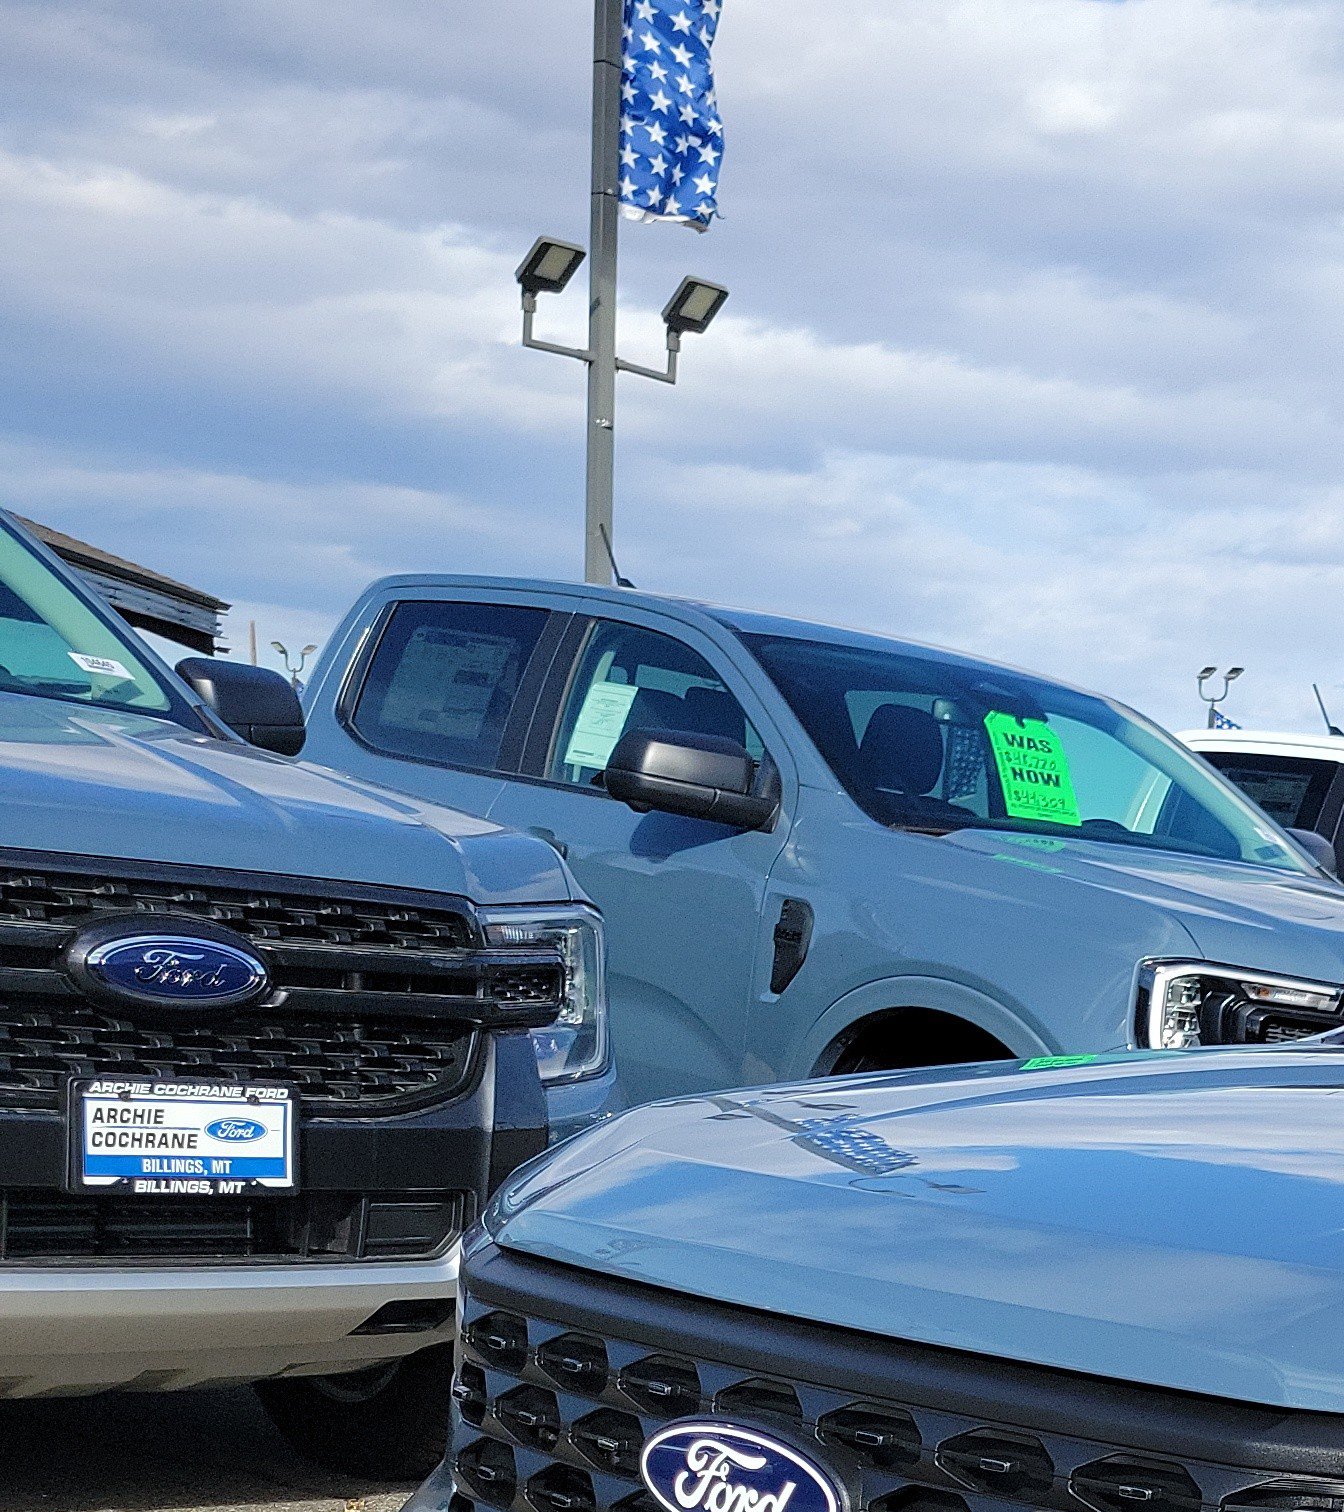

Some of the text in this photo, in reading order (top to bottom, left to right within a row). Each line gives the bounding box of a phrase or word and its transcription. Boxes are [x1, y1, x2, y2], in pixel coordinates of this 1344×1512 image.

[1003, 732, 1053, 753] WAS
[1011, 766, 1061, 788] NOW
[134, 949, 228, 987] Ford
[89, 1081, 289, 1099] ARCHIE COCHRANE FORD
[92, 1108, 165, 1124] ARCHIE
[217, 1121, 254, 1138] Ford
[91, 1131, 198, 1149] COCHRANE
[142, 1158, 232, 1175] BILLINGS, MT
[134, 1180, 245, 1195] BILLINGS, MT
